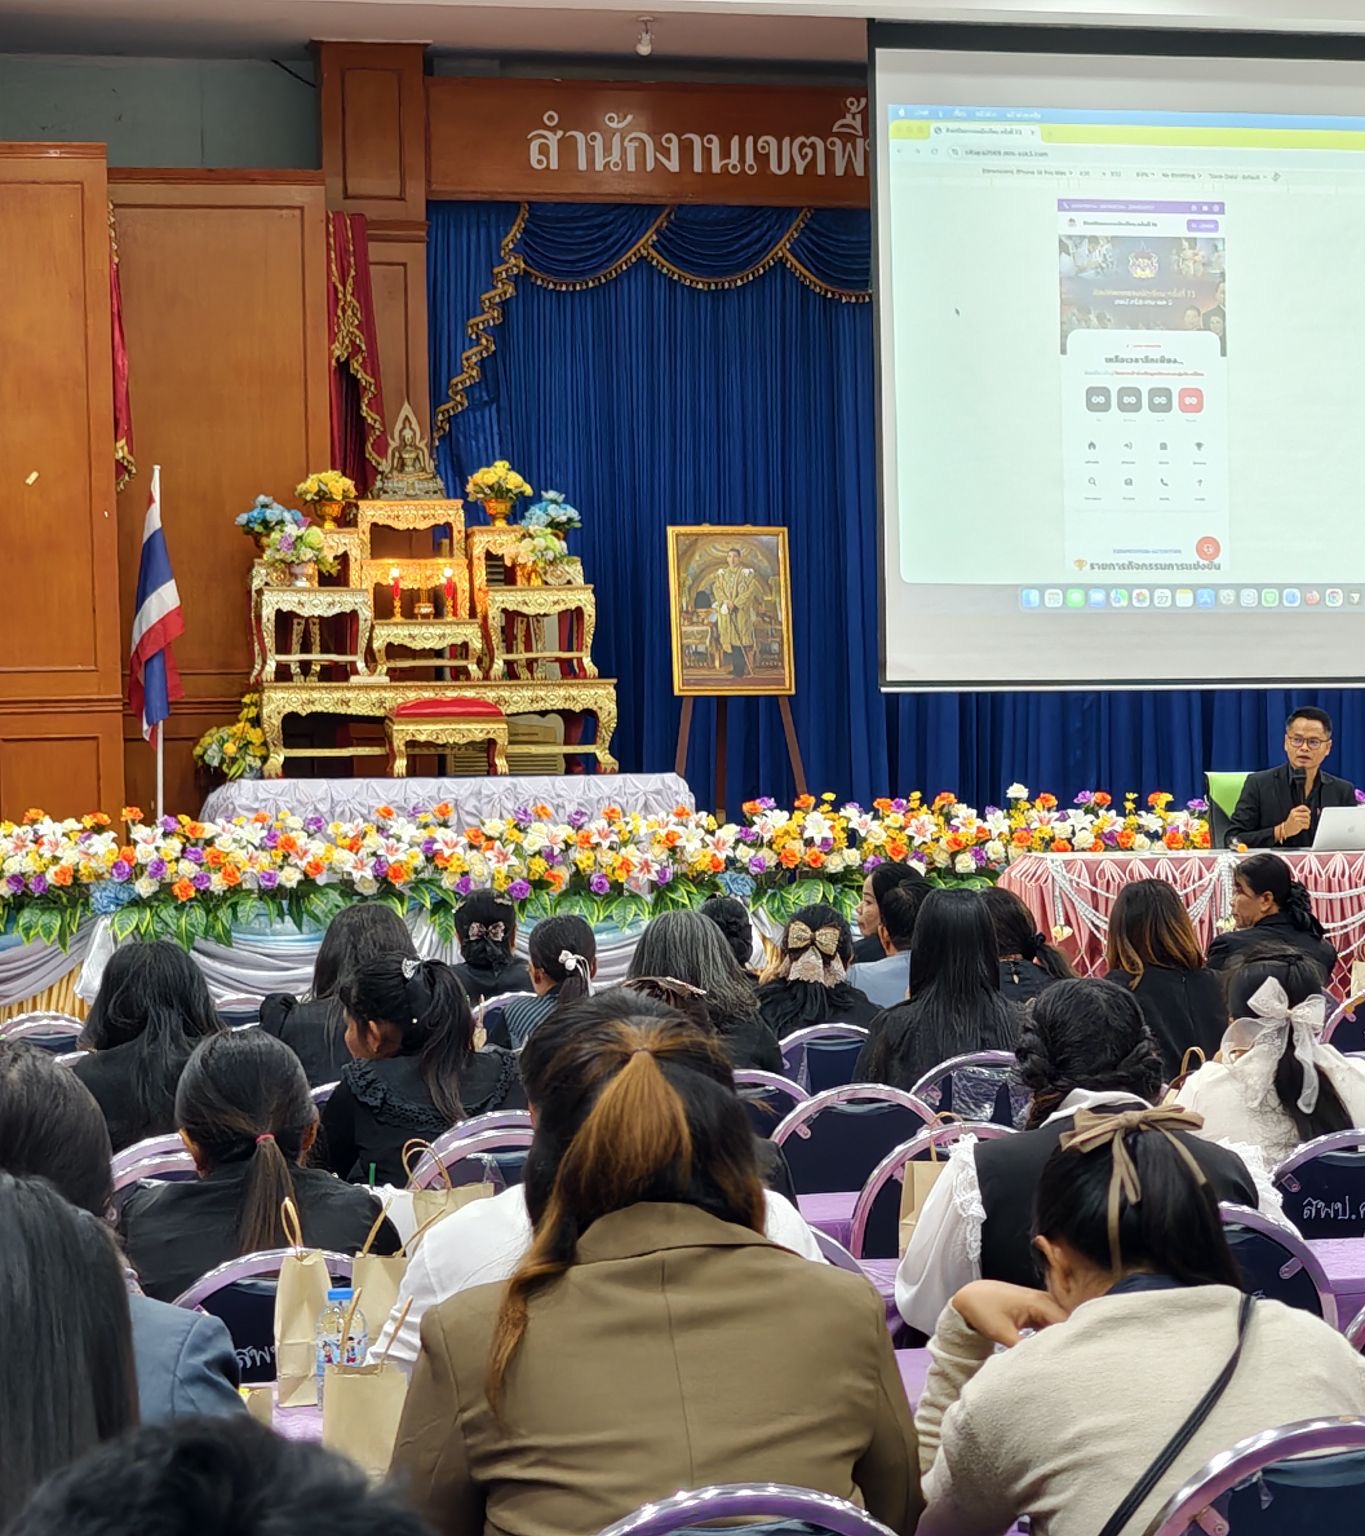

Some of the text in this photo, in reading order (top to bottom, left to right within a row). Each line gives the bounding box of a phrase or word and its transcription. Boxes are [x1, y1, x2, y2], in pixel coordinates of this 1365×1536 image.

[527, 97, 871, 177] สำนักงานเขตพื้
